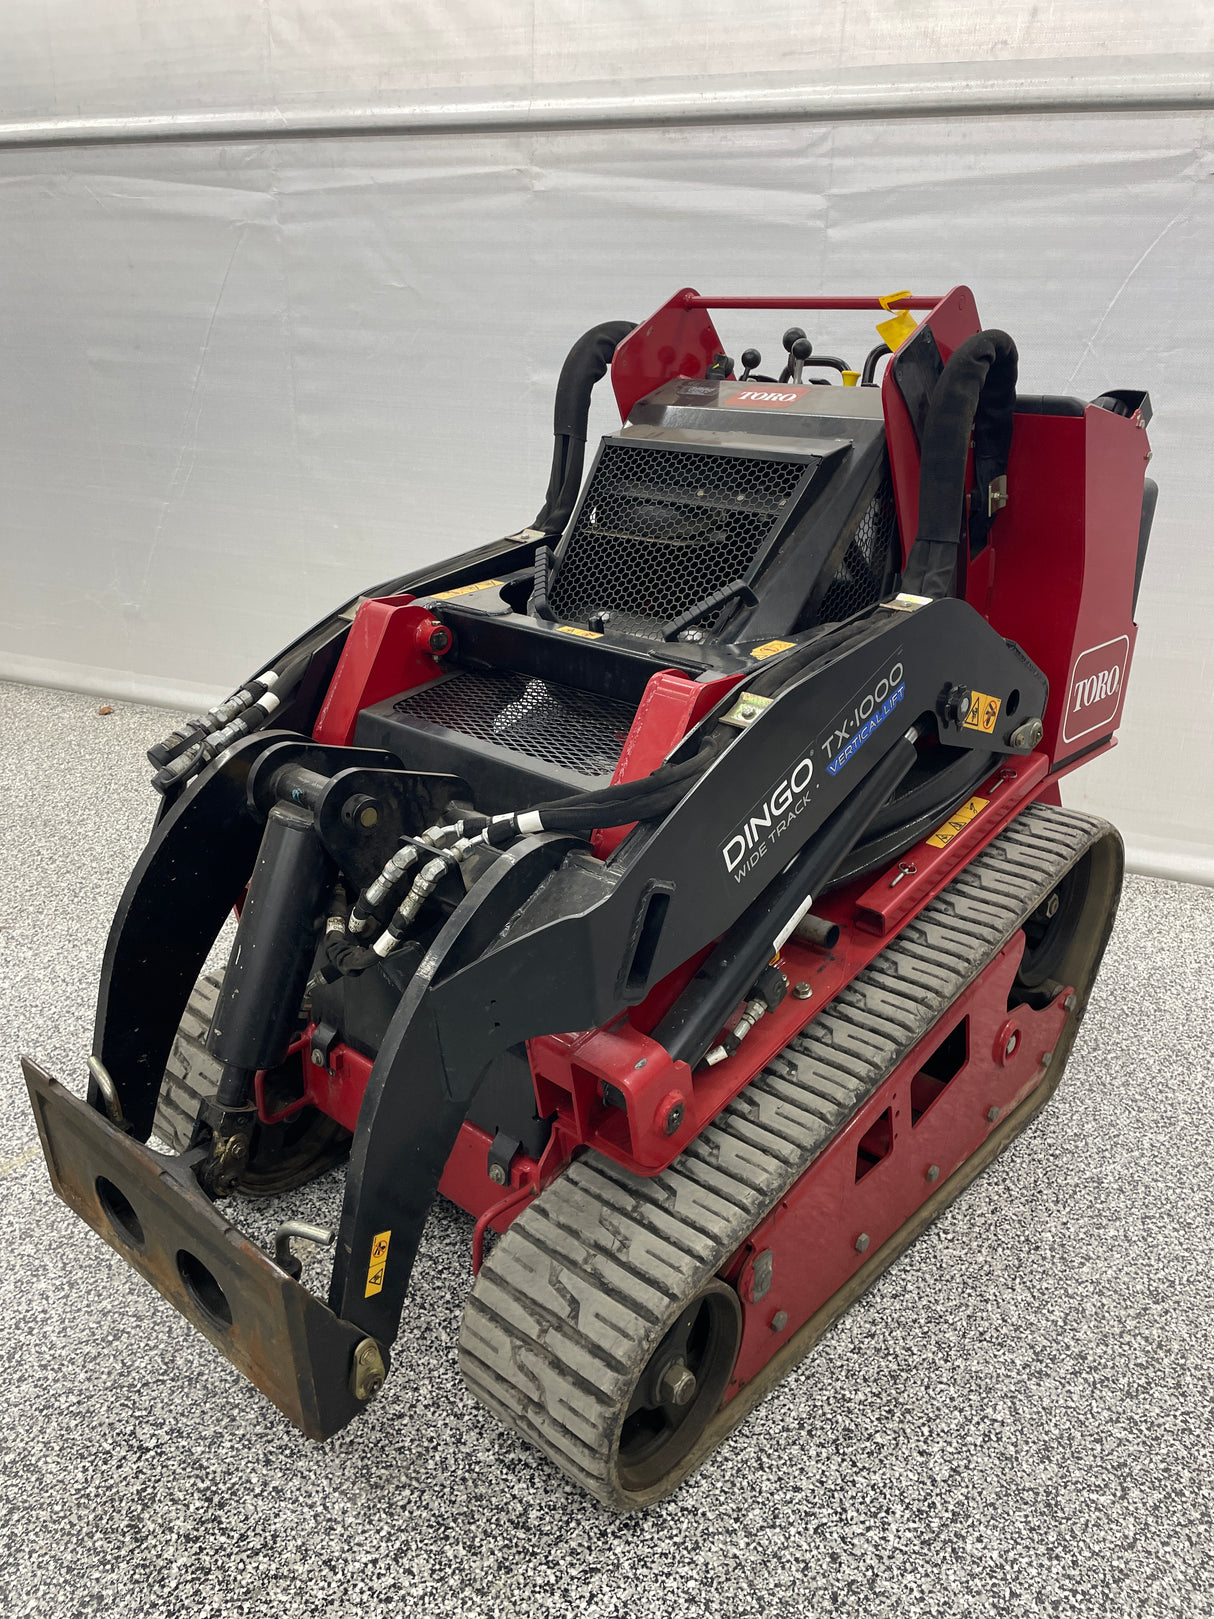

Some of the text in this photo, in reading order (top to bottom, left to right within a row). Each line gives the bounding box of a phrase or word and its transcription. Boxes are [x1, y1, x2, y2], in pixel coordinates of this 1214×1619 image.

[738, 391, 797, 402] TORO
[1073, 665, 1119, 712] TORO
[829, 686, 904, 772] VERTICAL LIFT
[734, 790, 812, 884] WIDE TRACK
